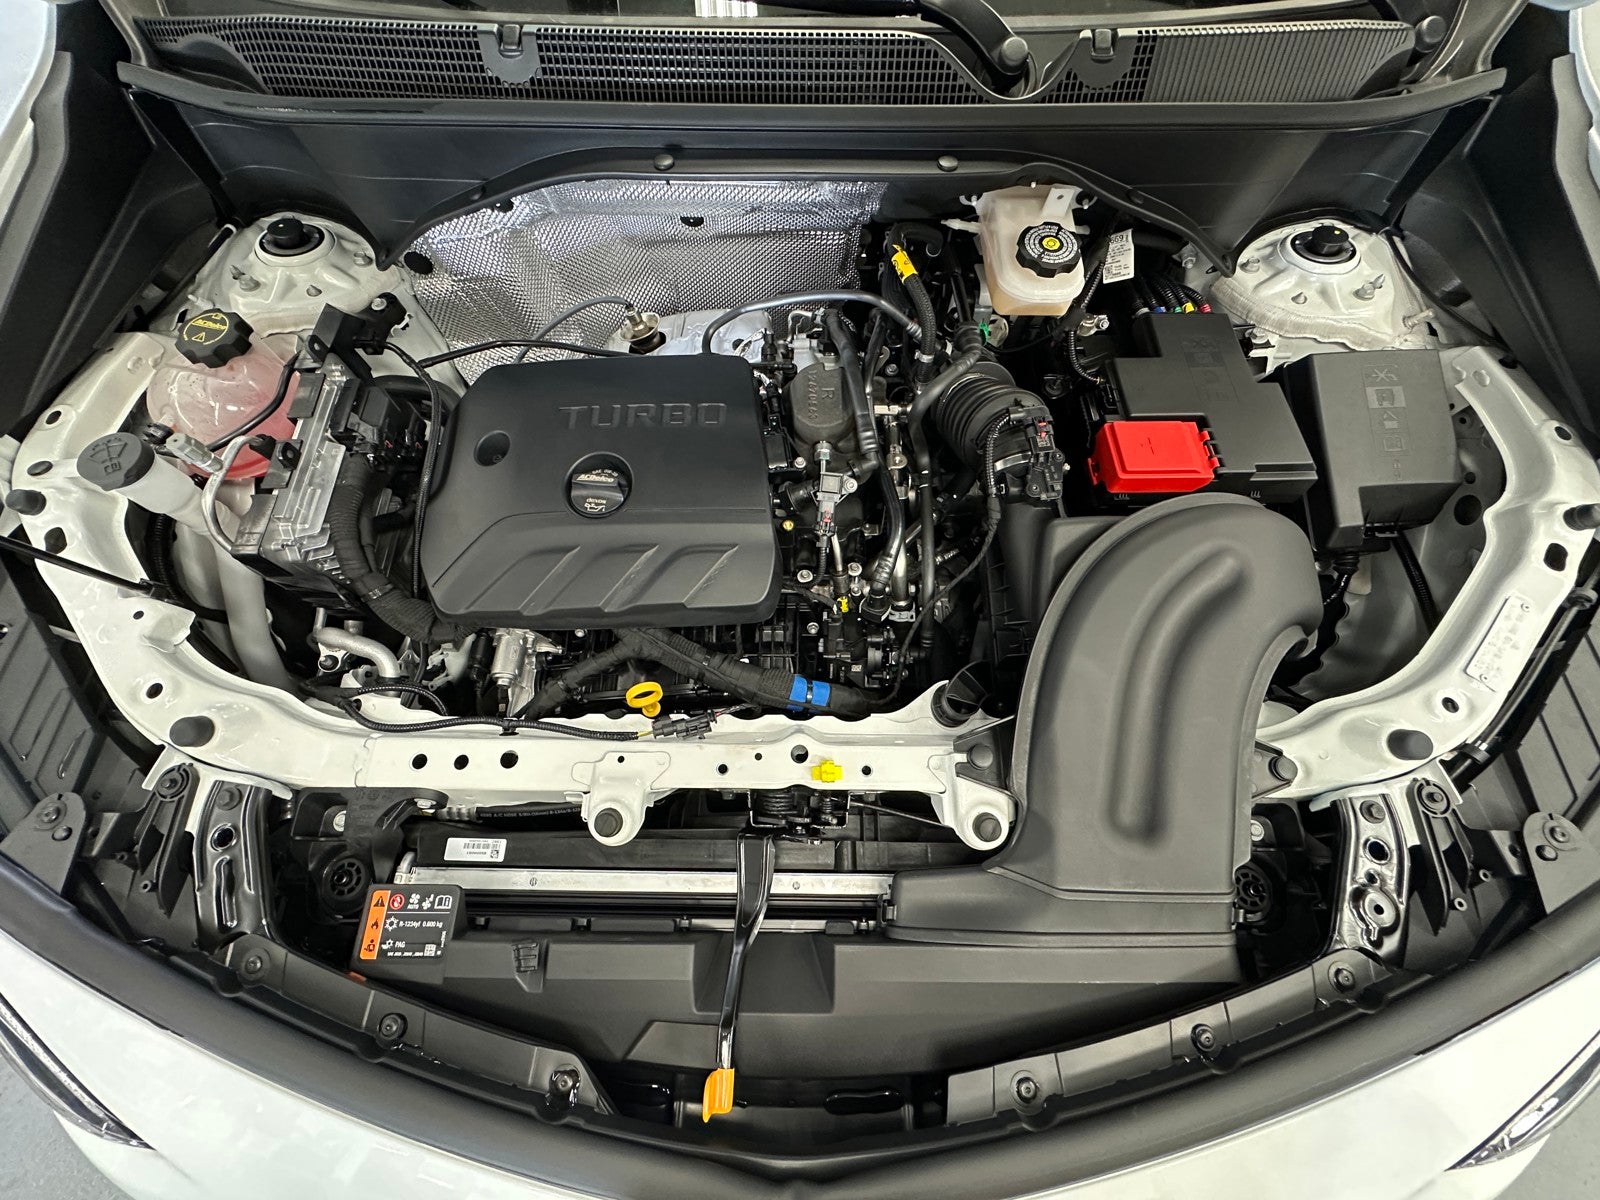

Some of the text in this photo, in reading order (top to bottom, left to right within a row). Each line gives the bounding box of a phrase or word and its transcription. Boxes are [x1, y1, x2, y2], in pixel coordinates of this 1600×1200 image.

[821, 387, 835, 399] R
[558, 403, 727, 430] TURBO
[576, 474, 615, 483] ACDelco
